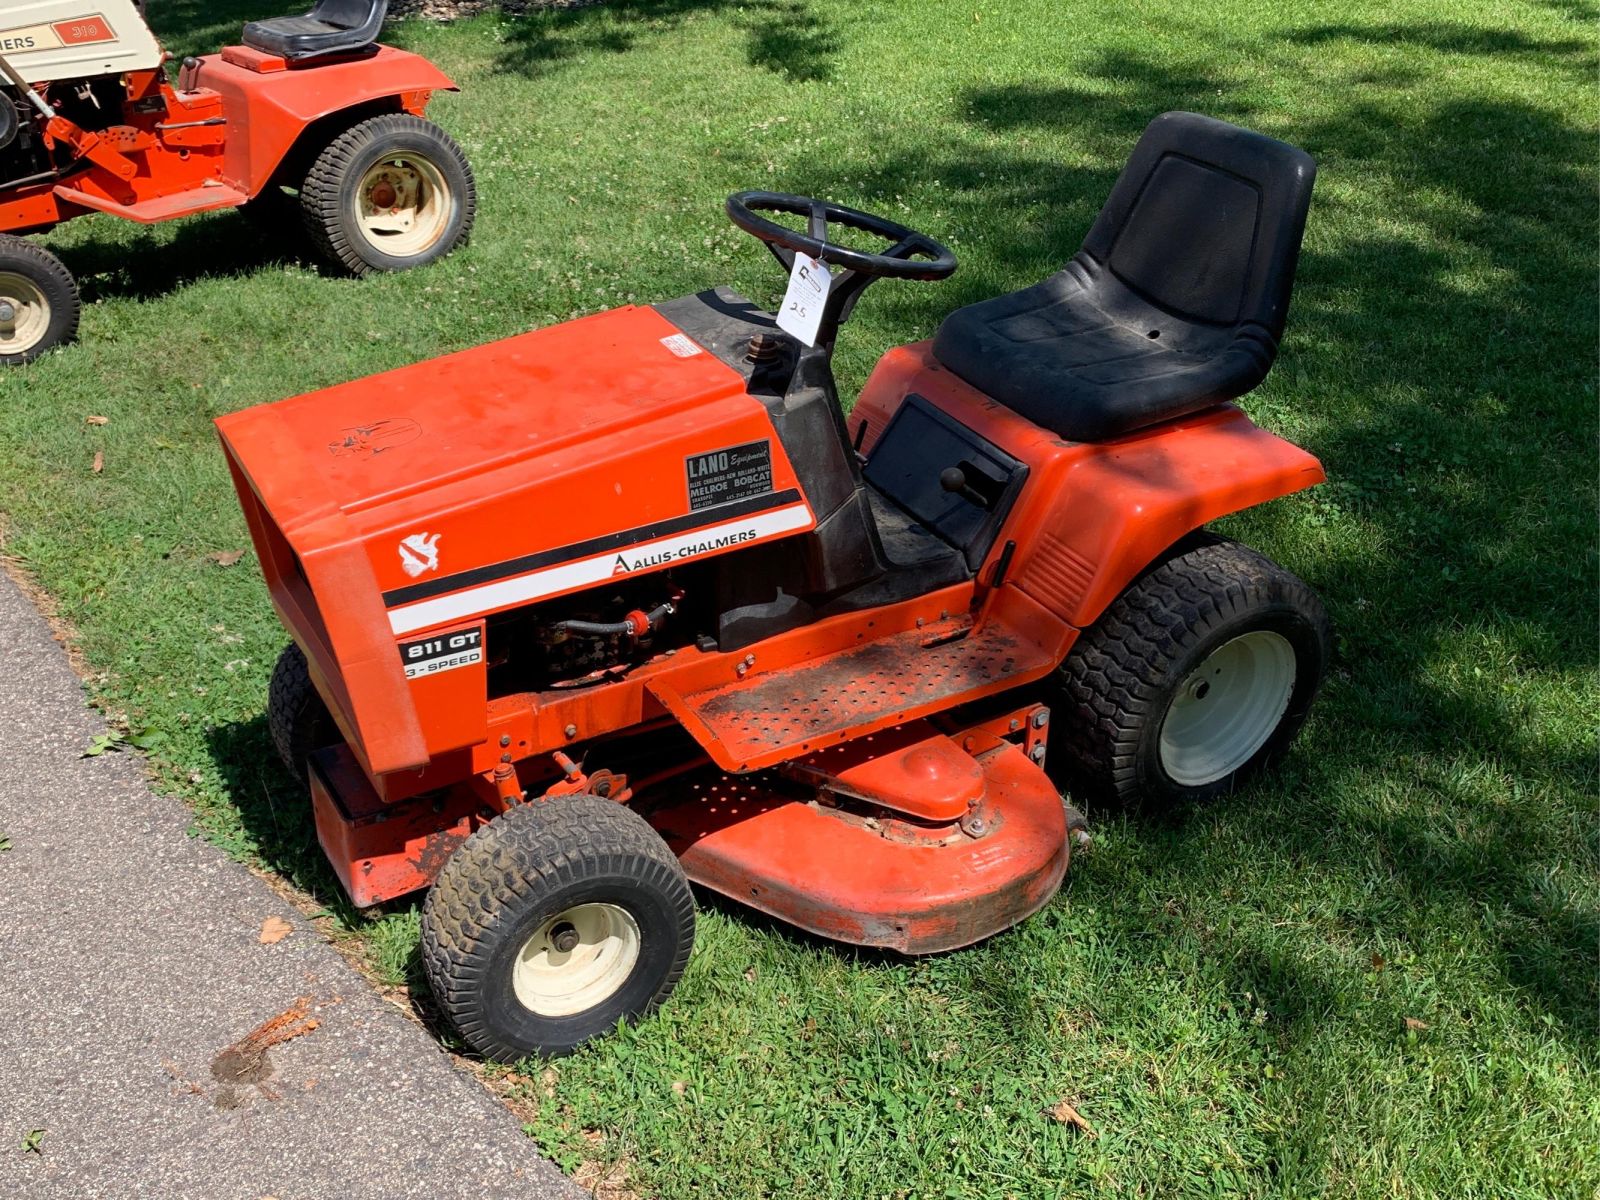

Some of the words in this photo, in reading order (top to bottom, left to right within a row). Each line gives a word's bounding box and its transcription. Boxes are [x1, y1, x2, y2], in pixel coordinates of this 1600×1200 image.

[71, 25, 97, 38] 310
[789, 302, 806, 318] 25
[688, 452, 729, 478] LAND
[690, 481, 728, 498] MELROE
[734, 471, 770, 487] BOBCAT
[633, 529, 757, 571] ALLIS-CHALMERS
[408, 640, 442, 658] 811
[449, 632, 480, 648] GT
